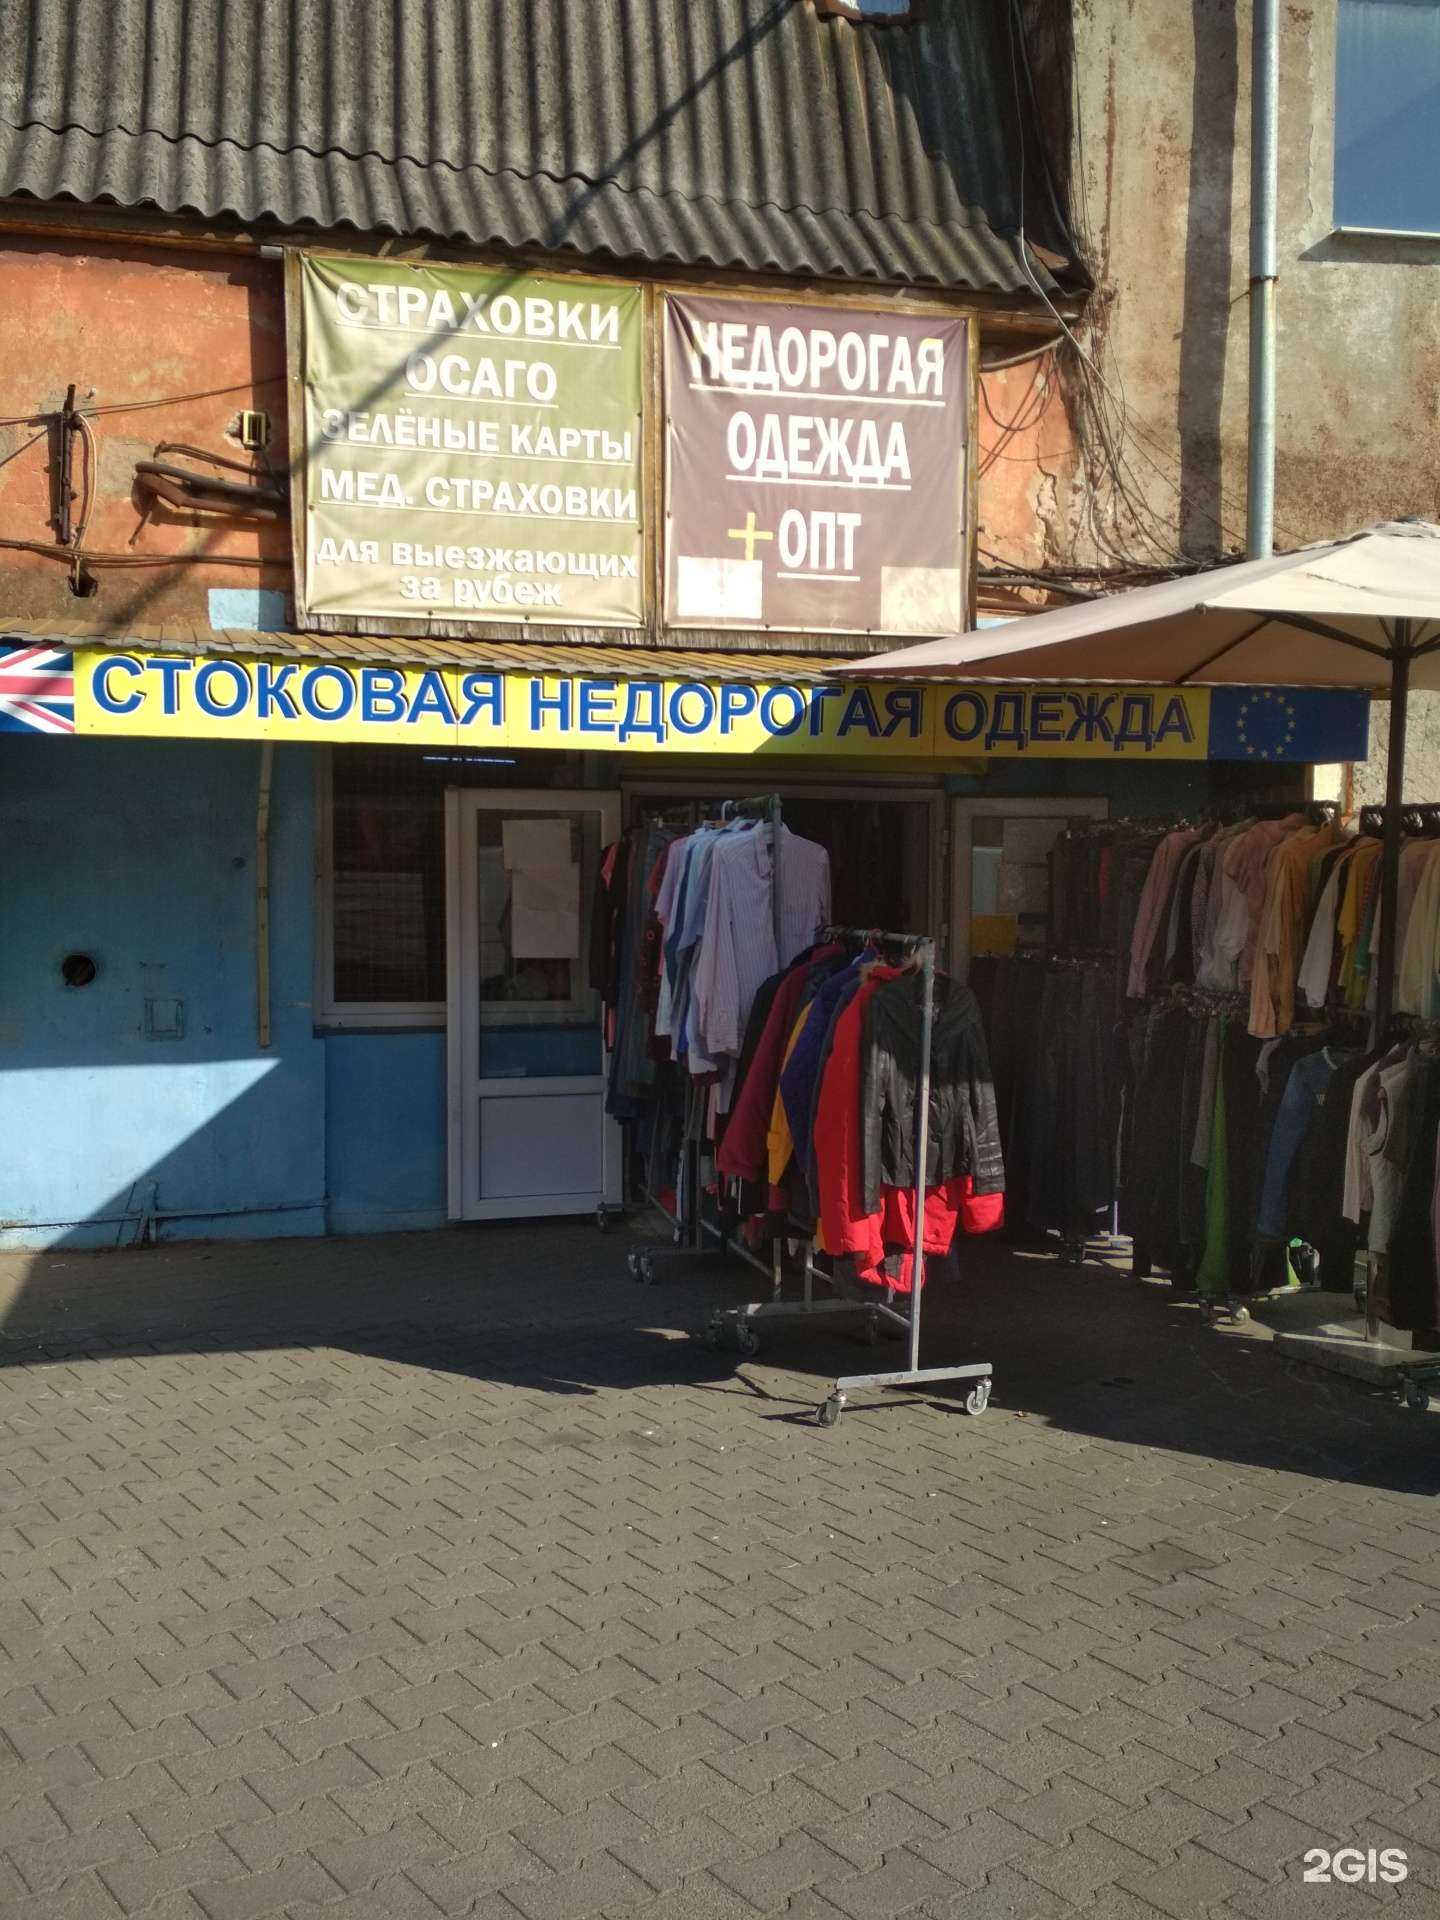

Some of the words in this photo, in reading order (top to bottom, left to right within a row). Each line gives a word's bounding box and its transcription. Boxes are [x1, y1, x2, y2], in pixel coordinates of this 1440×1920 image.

[336, 282, 620, 342] СТРАХОВКИ
[405, 352, 558, 401] ОСАГО
[690, 321, 945, 395] НЕДОРОГАЯ
[321, 408, 500, 452] ЗЕЛЁНЫЕ
[511, 424, 632, 461] КАРТЫ
[727, 411, 912, 485] ОДЕЖДА
[320, 469, 414, 506] МЕД.
[426, 477, 637, 518] СТРАХОВКИ
[317, 538, 379, 565] для
[392, 542, 638, 581] выезжающих
[778, 509, 862, 571] ОПТ
[400, 576, 441, 600] за
[453, 574, 562, 607] рубеж
[92, 654, 504, 727] СТОКОВАЯ
[530, 679, 923, 744] НЕДОРОГАЯ
[944, 690, 1196, 752] ОДЕЖДА
